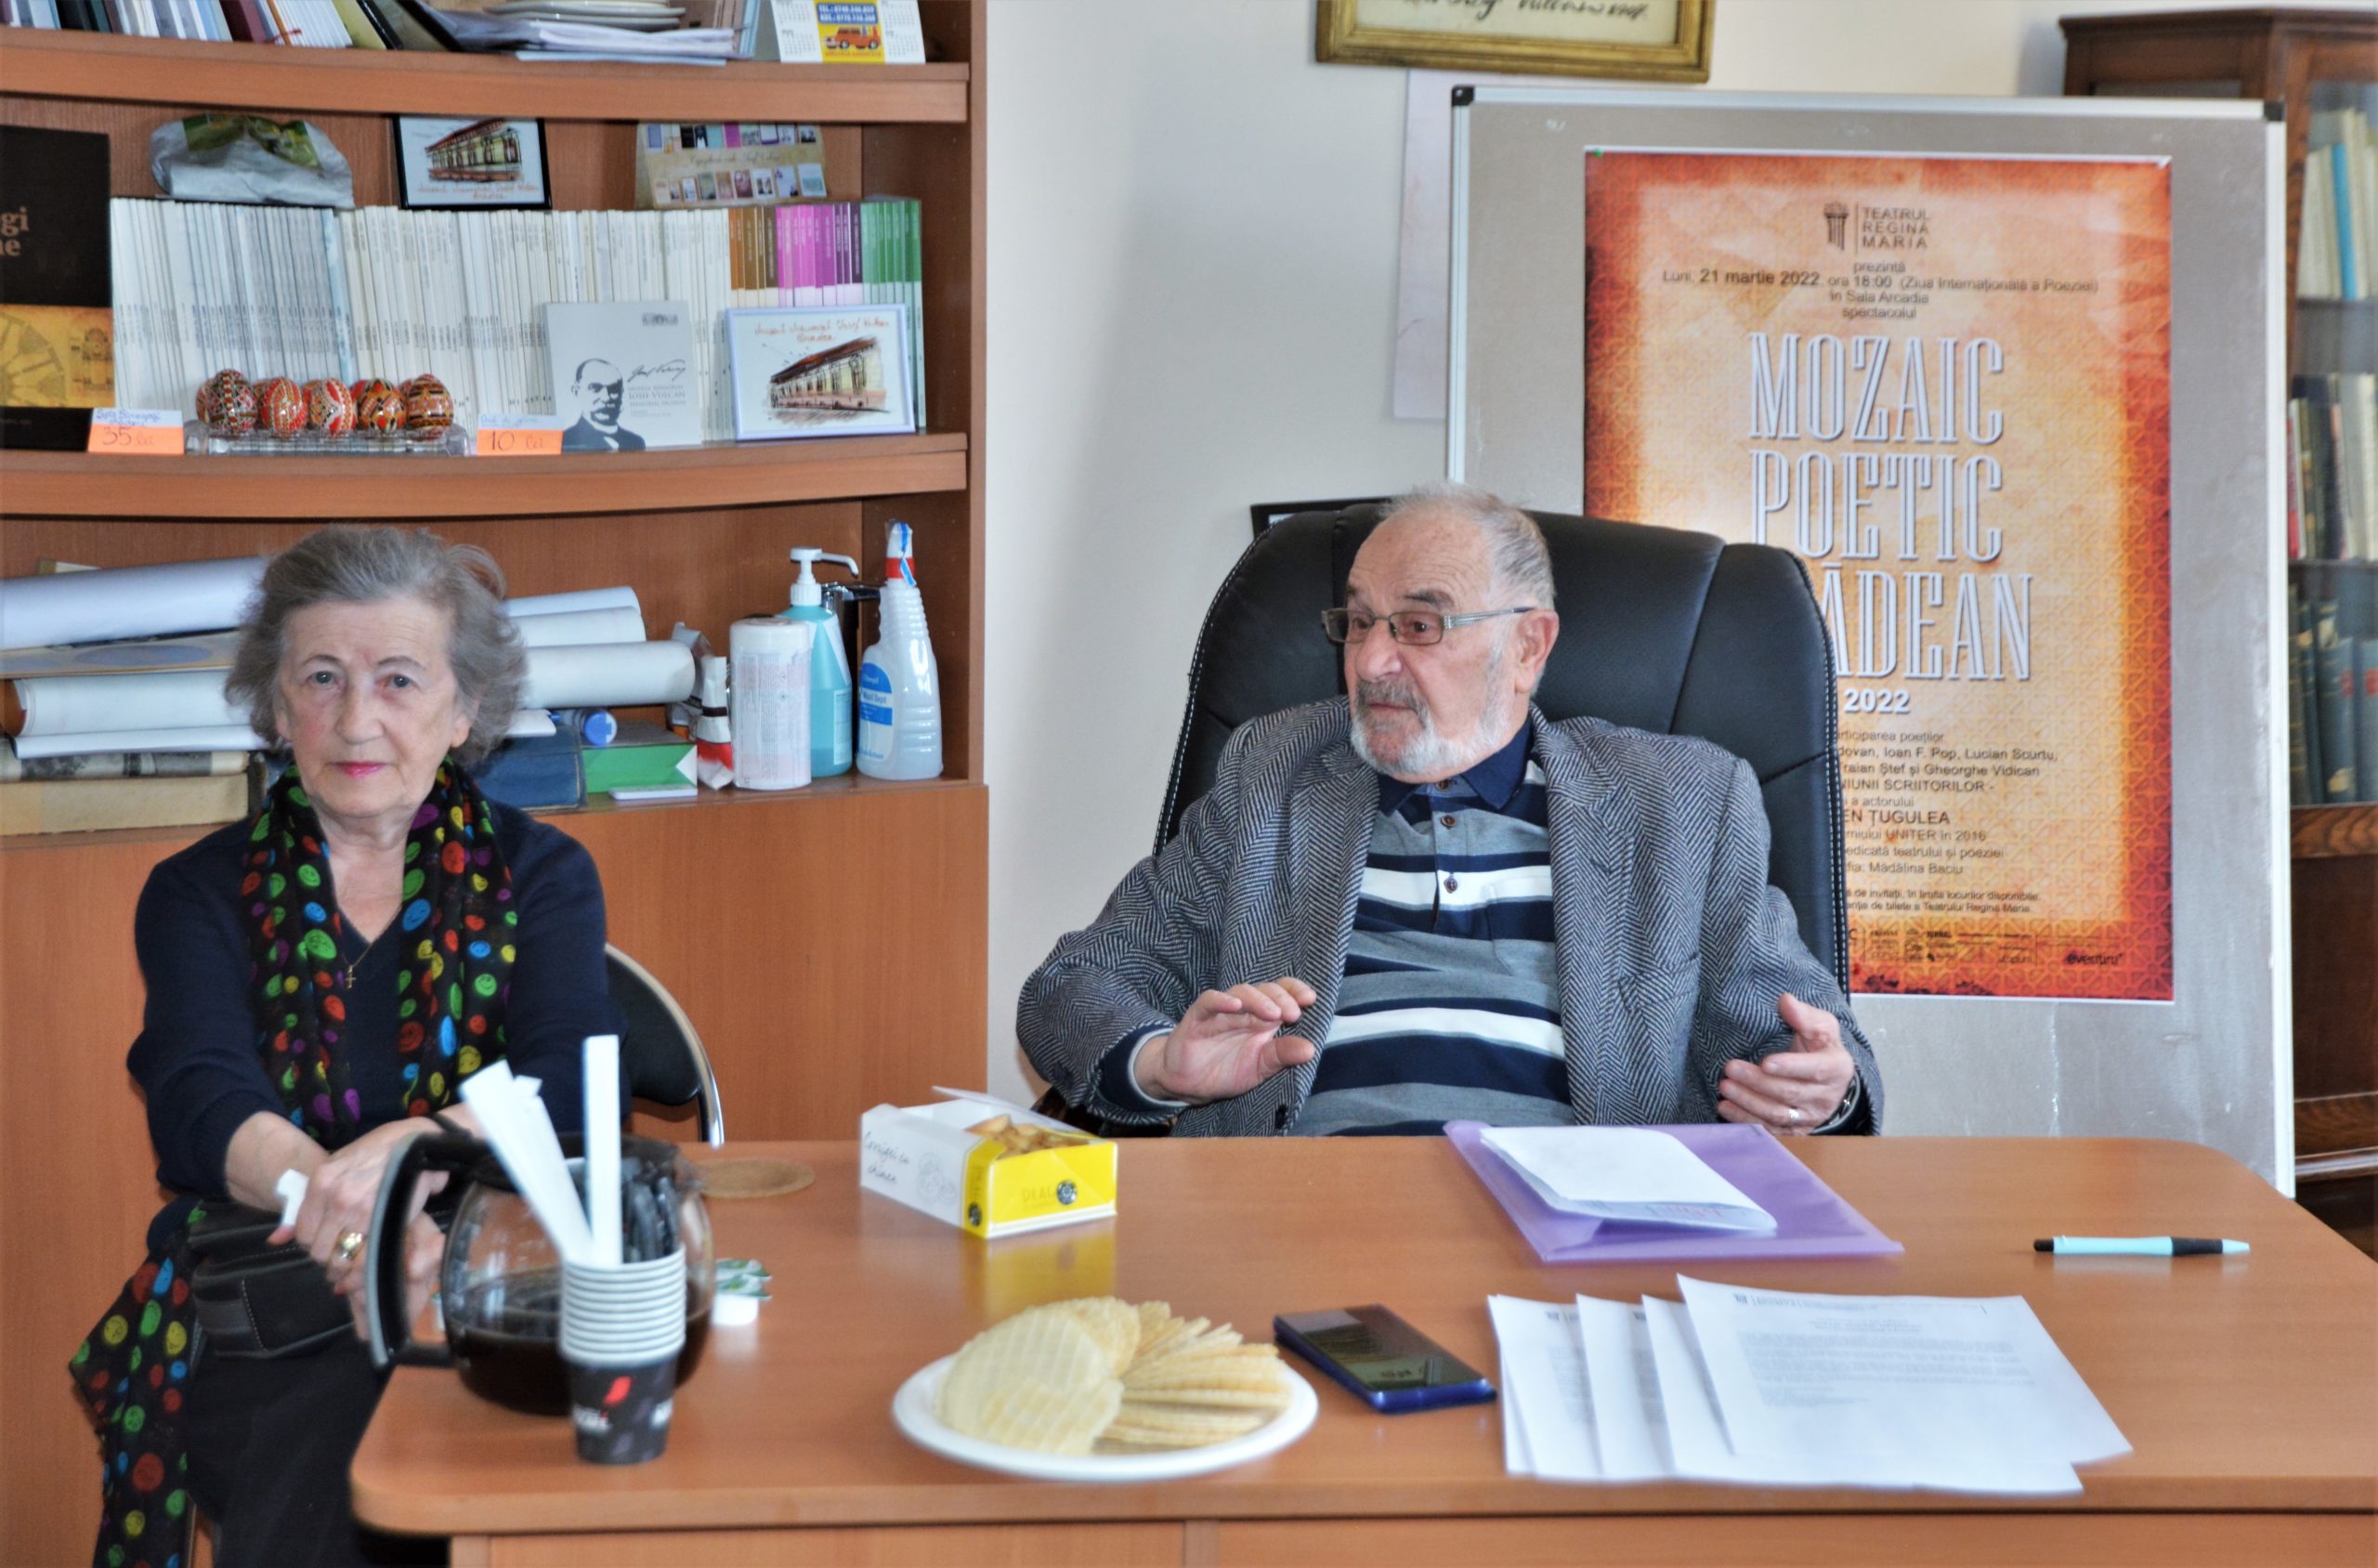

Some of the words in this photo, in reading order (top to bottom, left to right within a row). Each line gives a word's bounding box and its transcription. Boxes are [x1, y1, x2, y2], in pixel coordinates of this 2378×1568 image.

[1862, 206, 1929, 220] TEATRUL
[1862, 221, 1929, 234] REGINA
[1862, 236, 1928, 249] MARIA
[1853, 261, 1906, 274] prezintă
[1699, 268, 1718, 283] 21
[1725, 269, 1775, 284] martie
[1828, 278, 1849, 287] ora
[1854, 276, 1892, 288] 18:00
[1900, 276, 1934, 291] (Ziua
[2031, 281, 2040, 291] a
[2044, 280, 2099, 294] Poeziei)
[1847, 291, 1875, 303] Sala
[1878, 292, 1929, 305] Arcadia
[1842, 306, 1916, 320] spectacolul
[1748, 332, 2005, 445] MOZAIC
[102, 426, 132, 446] 35
[490, 430, 515, 451] 10
[1749, 450, 2004, 563] POETIC
[1817, 562, 2033, 681] ĂDEAN
[1843, 688, 1910, 713] 2022
[1900, 731, 1944, 744] poeților
[1838, 746, 1879, 758] dovan,
[1884, 747, 1912, 758] Ioan
[1915, 748, 1927, 758] F.
[1931, 748, 1961, 761] Pop,
[1965, 749, 2008, 760] Lucian
[2012, 749, 2058, 762] Scurtu,
[1843, 764, 1875, 774] raian
[1909, 764, 1920, 777] și
[1925, 764, 1988, 777] Gheorghe
[1993, 765, 2040, 777] Vidican
[1884, 778, 1985, 792] SCRIITORILOR
[1862, 795, 1914, 807] actorului
[1843, 808, 1862, 823] EN
[1868, 809, 1951, 827] ȚUGULEA
[1847, 828, 1882, 840] miului
[1886, 829, 1936, 841] UNITER
[1940, 829, 1952, 841] în
[1846, 844, 1889, 856] edicată
[1893, 845, 1942, 856] teatrului
[1946, 847, 1956, 860] și
[1960, 847, 2004, 859] poeziei
[1870, 861, 1925, 873] Mădălina
[1929, 863, 1964, 875] Baciu
[1855, 889, 1867, 897] de
[1871, 902, 1884, 910] de
[1886, 902, 1911, 911] bilete
[1923, 902, 1964, 912] Teatrului
[1966, 903, 2001, 914] Regina
[2003, 904, 2031, 913] Maria
